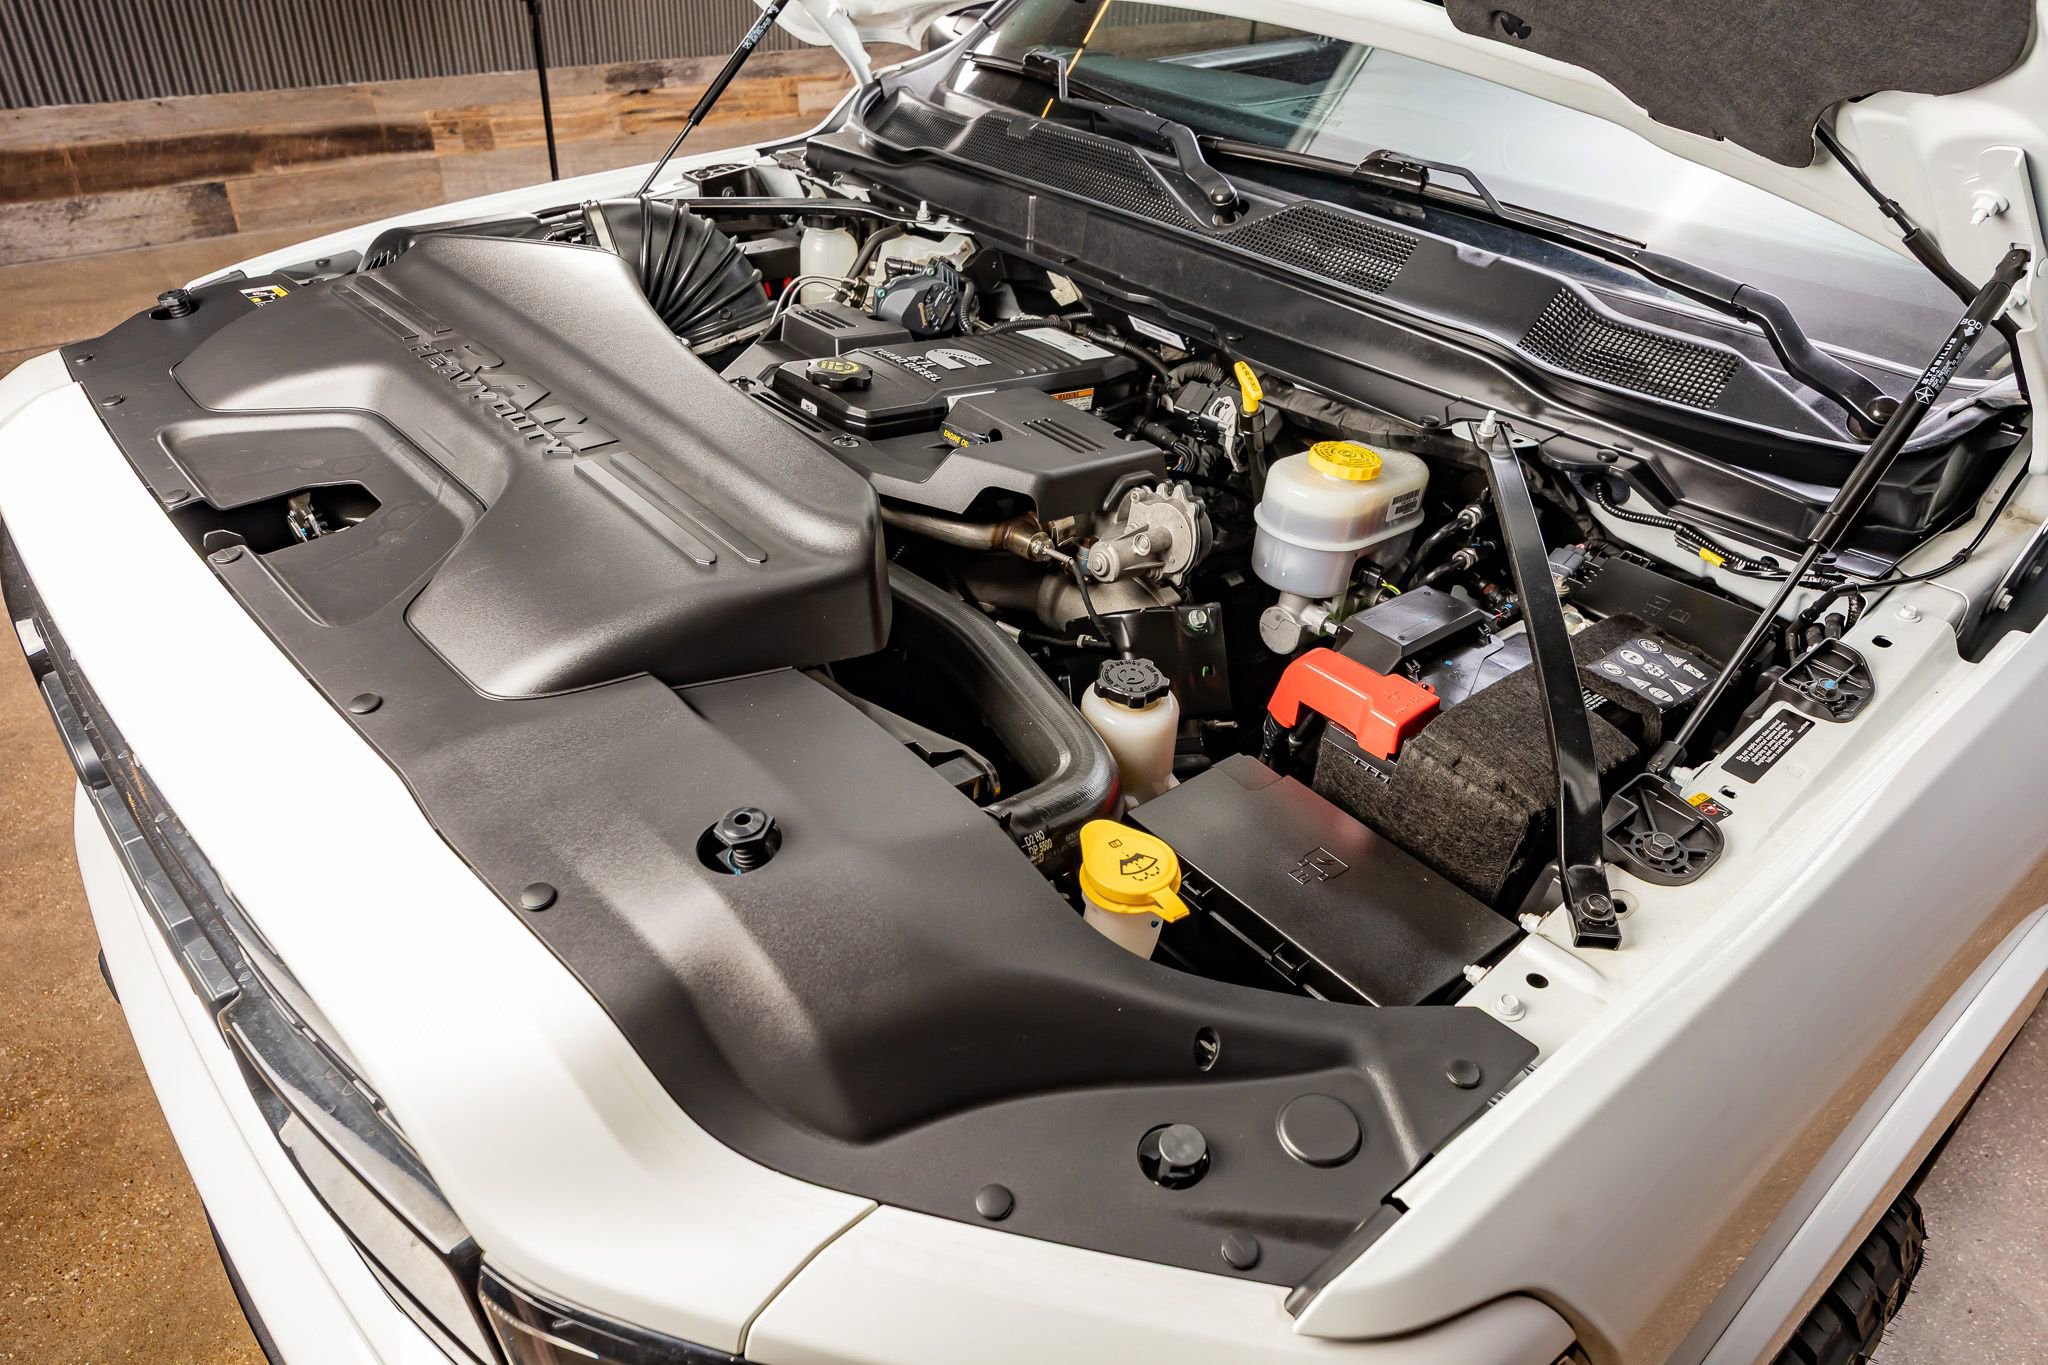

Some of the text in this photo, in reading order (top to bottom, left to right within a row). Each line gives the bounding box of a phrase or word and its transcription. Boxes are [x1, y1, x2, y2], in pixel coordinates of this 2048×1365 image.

[410, 342, 574, 455] HEAVY DUTY
[431, 336, 619, 452] RAM
[872, 348, 942, 382] TURBO DIESEL
[1921, 337, 1958, 385] STABILUS
